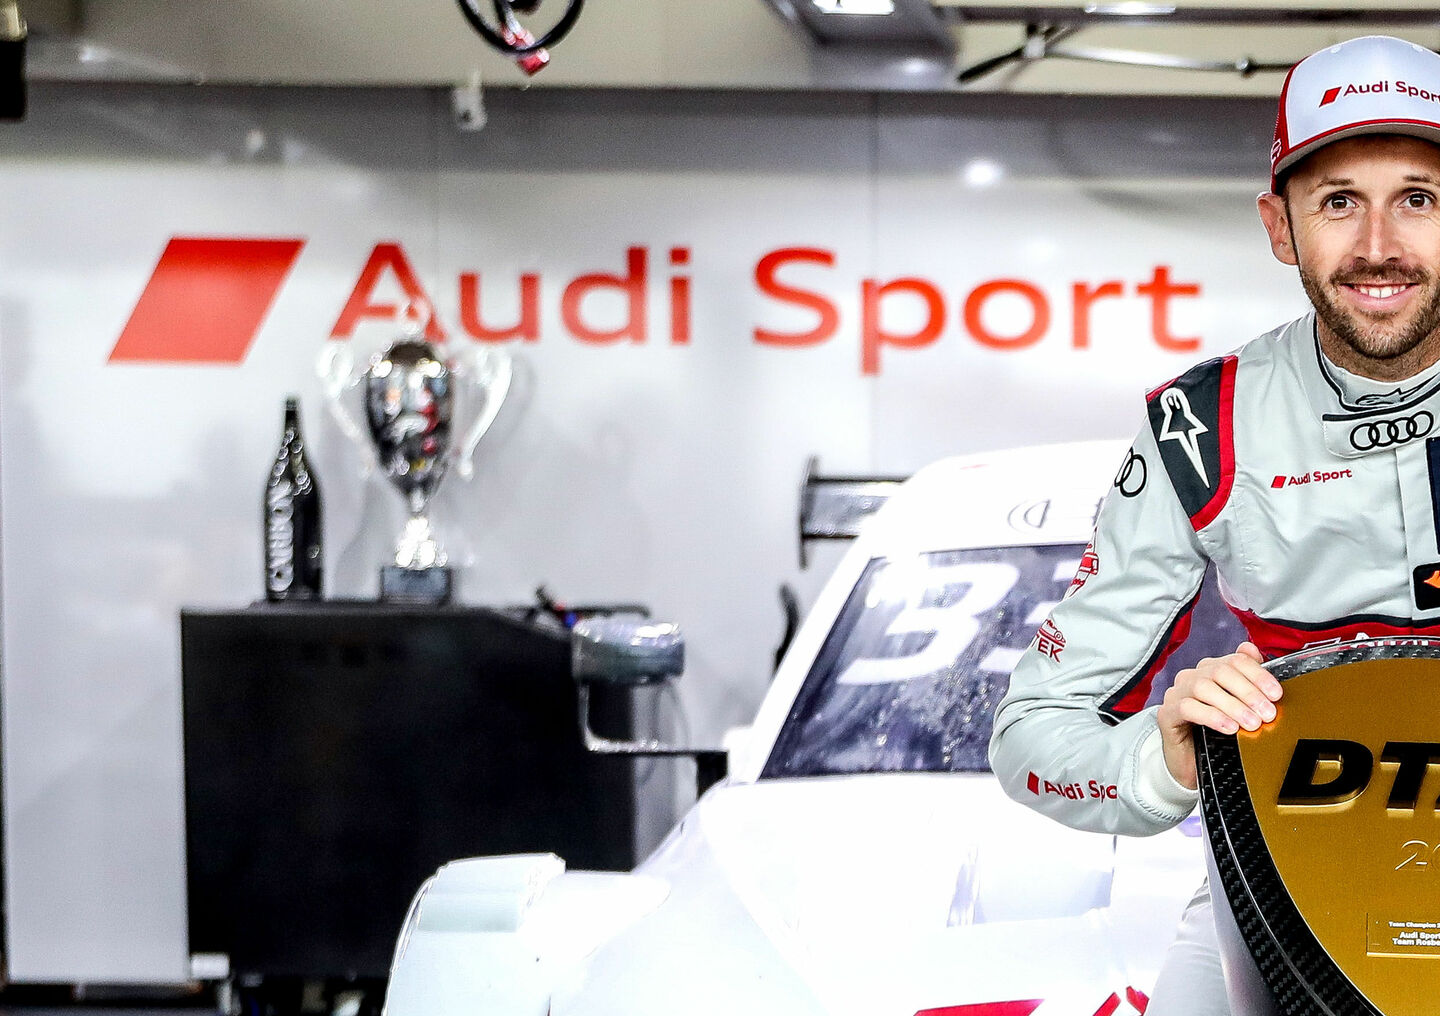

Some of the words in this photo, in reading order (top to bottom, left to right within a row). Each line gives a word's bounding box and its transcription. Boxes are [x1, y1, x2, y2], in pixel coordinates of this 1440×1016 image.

[1343, 81, 1389, 97] Audi
[328, 242, 694, 346] Audi
[752, 246, 1202, 376] Sport
[1288, 472, 1311, 486] Audi
[1313, 469, 1352, 483] Sport
[1043, 780, 1085, 800] Audi
[1088, 779, 1118, 804] Spo
[1400, 931, 1418, 939] Audi
